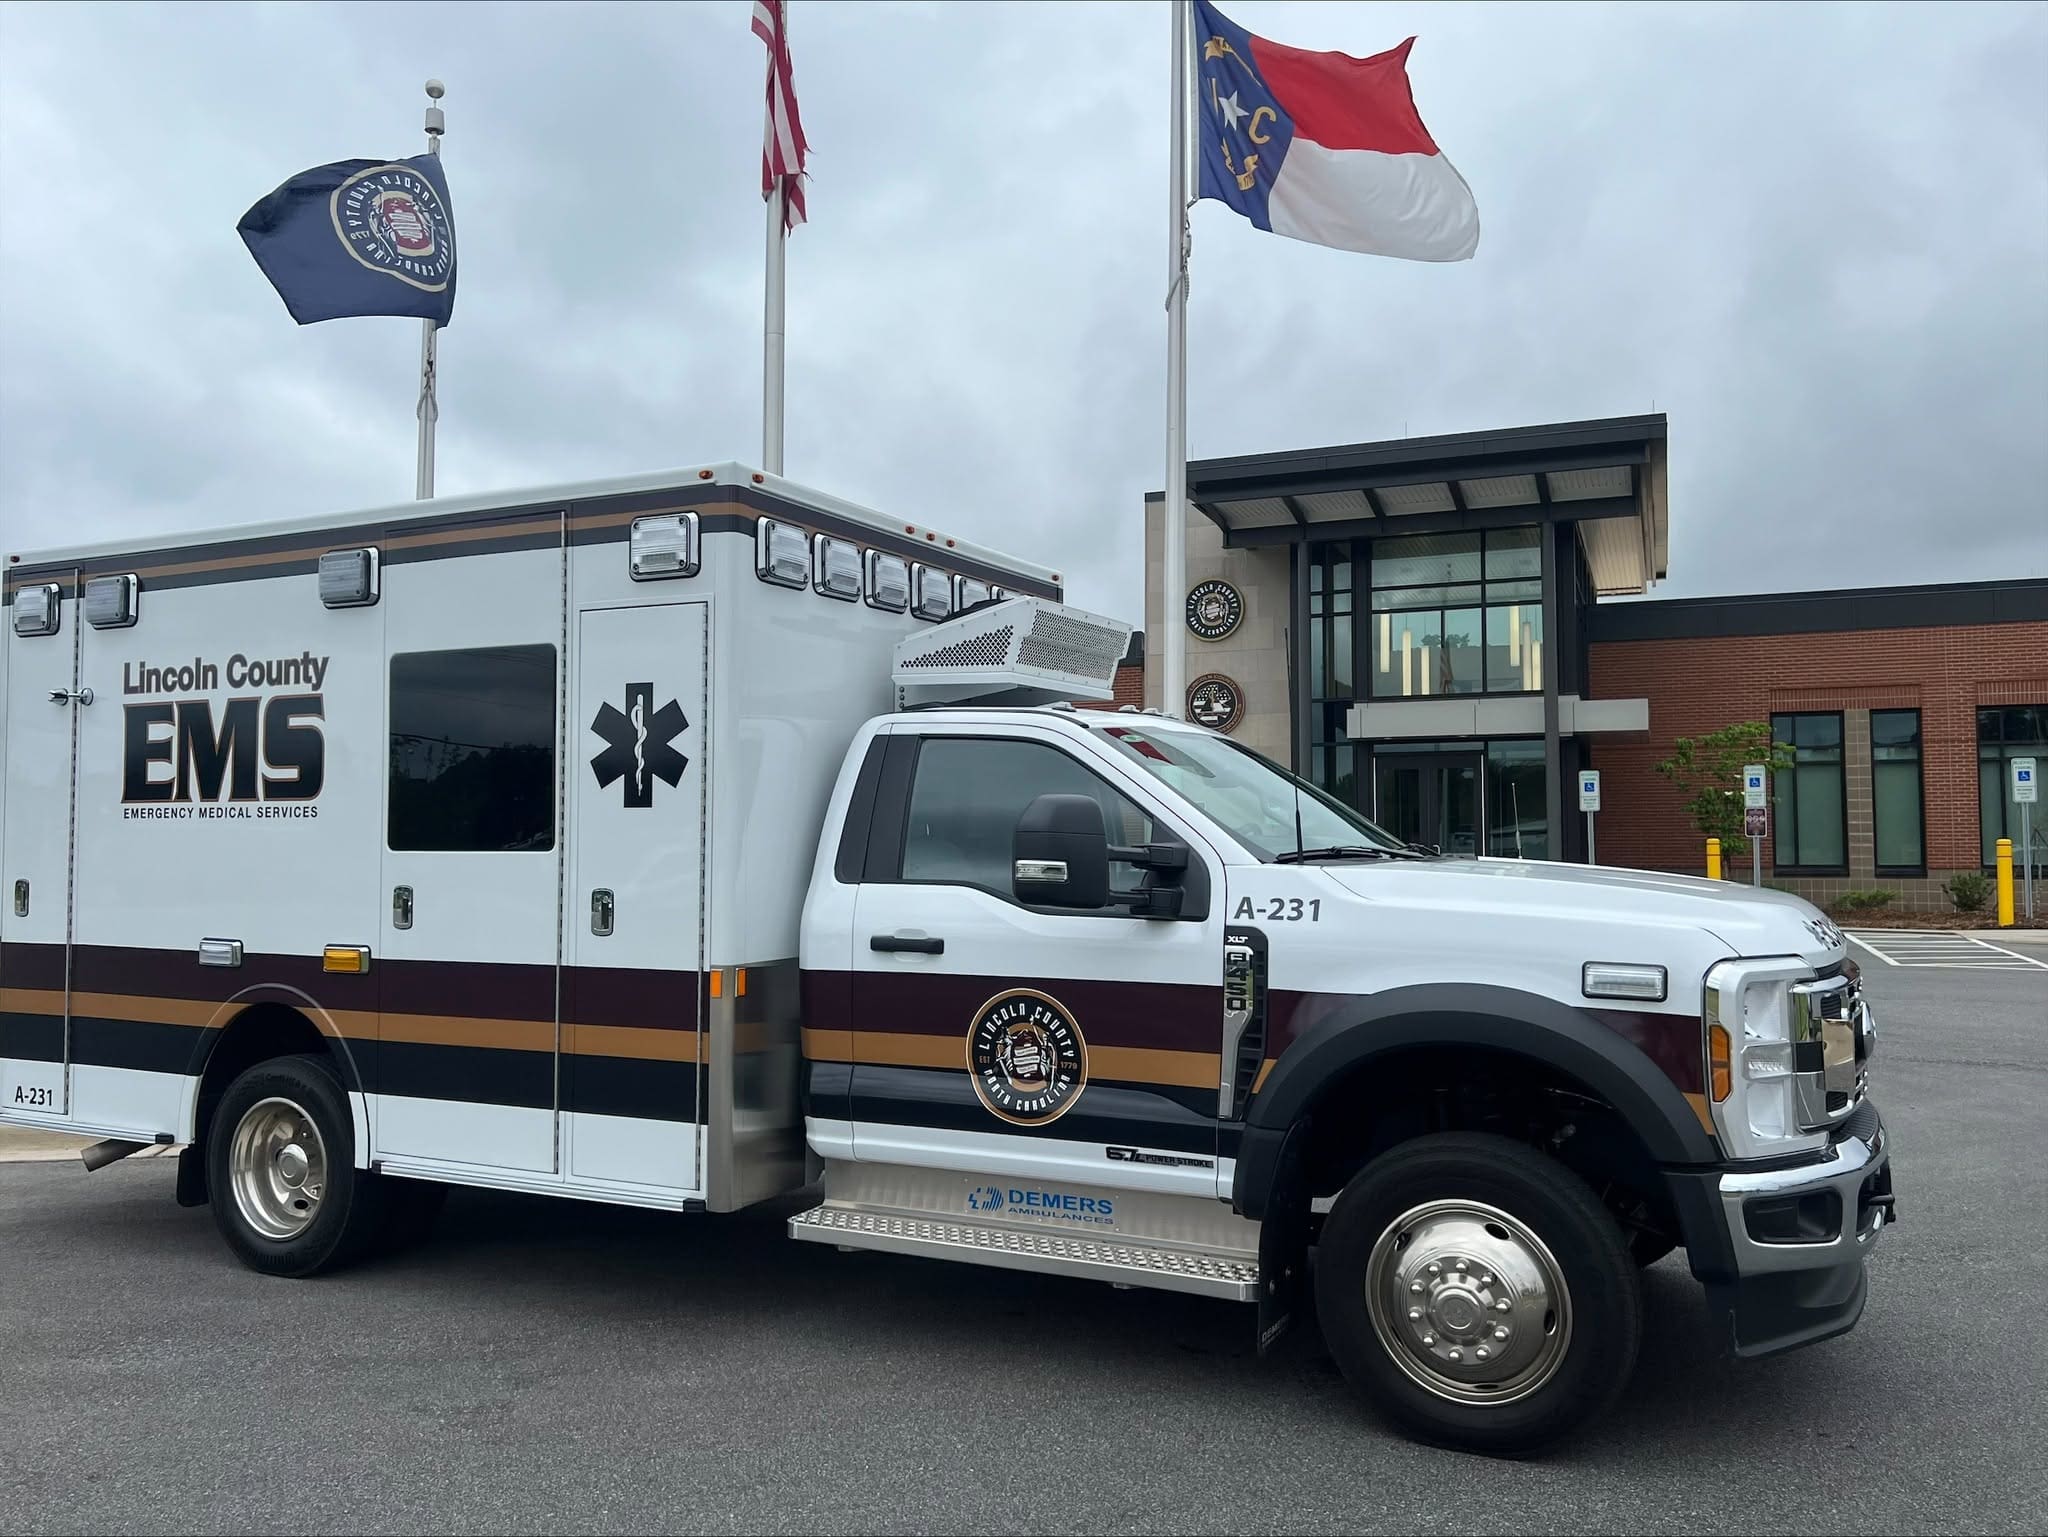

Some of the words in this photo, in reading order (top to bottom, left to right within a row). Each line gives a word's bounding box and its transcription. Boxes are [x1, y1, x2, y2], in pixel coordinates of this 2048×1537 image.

[123, 656, 219, 695] Lincoln
[226, 651, 330, 692] County
[120, 692, 326, 804] EMS
[123, 807, 194, 820] EMERGENCY
[199, 807, 252, 819] MEDICAL
[257, 806, 318, 819] SERVICES
[1234, 896, 1321, 922] A-231
[1226, 935, 1249, 943] XLT
[979, 1003, 1026, 1050] LINCOLN
[1034, 1006, 1075, 1057] COUNTY
[15, 1086, 52, 1106] A-231
[983, 1068, 1012, 1105] NORTH
[1016, 1074, 1071, 1112] CAROLINA
[1008, 1188, 1113, 1215] DEMERS
[1008, 1206, 1114, 1226] AMBULANCES
